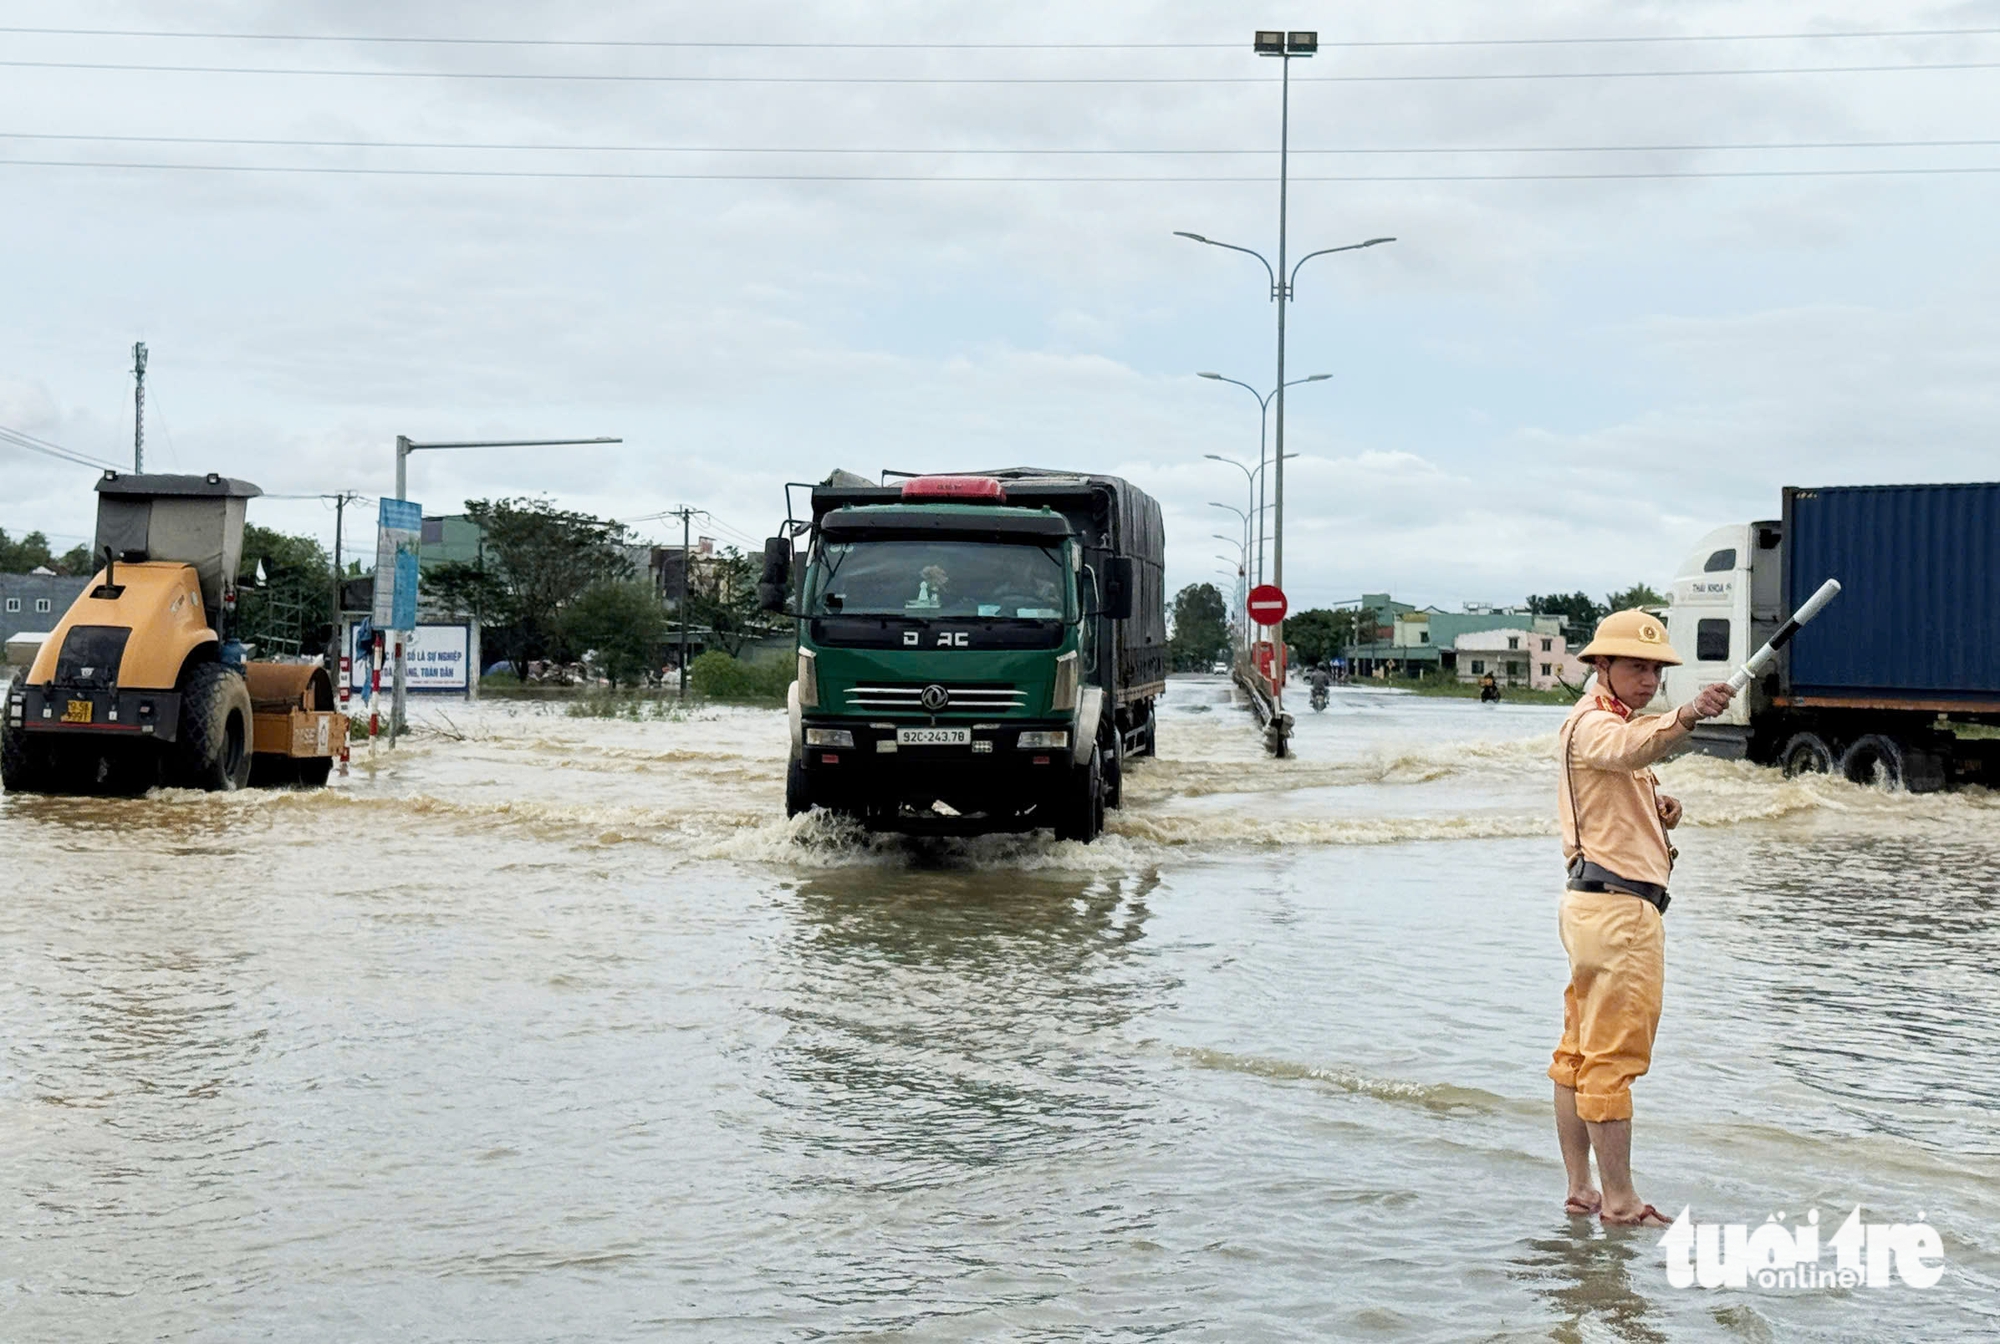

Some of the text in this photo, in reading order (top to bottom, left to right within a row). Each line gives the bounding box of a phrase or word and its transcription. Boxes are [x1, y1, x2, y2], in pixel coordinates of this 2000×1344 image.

[417, 649, 426, 662] LÀ
[437, 650, 462, 664] NGHIỆP
[903, 731, 965, 743] 92C-243.78
